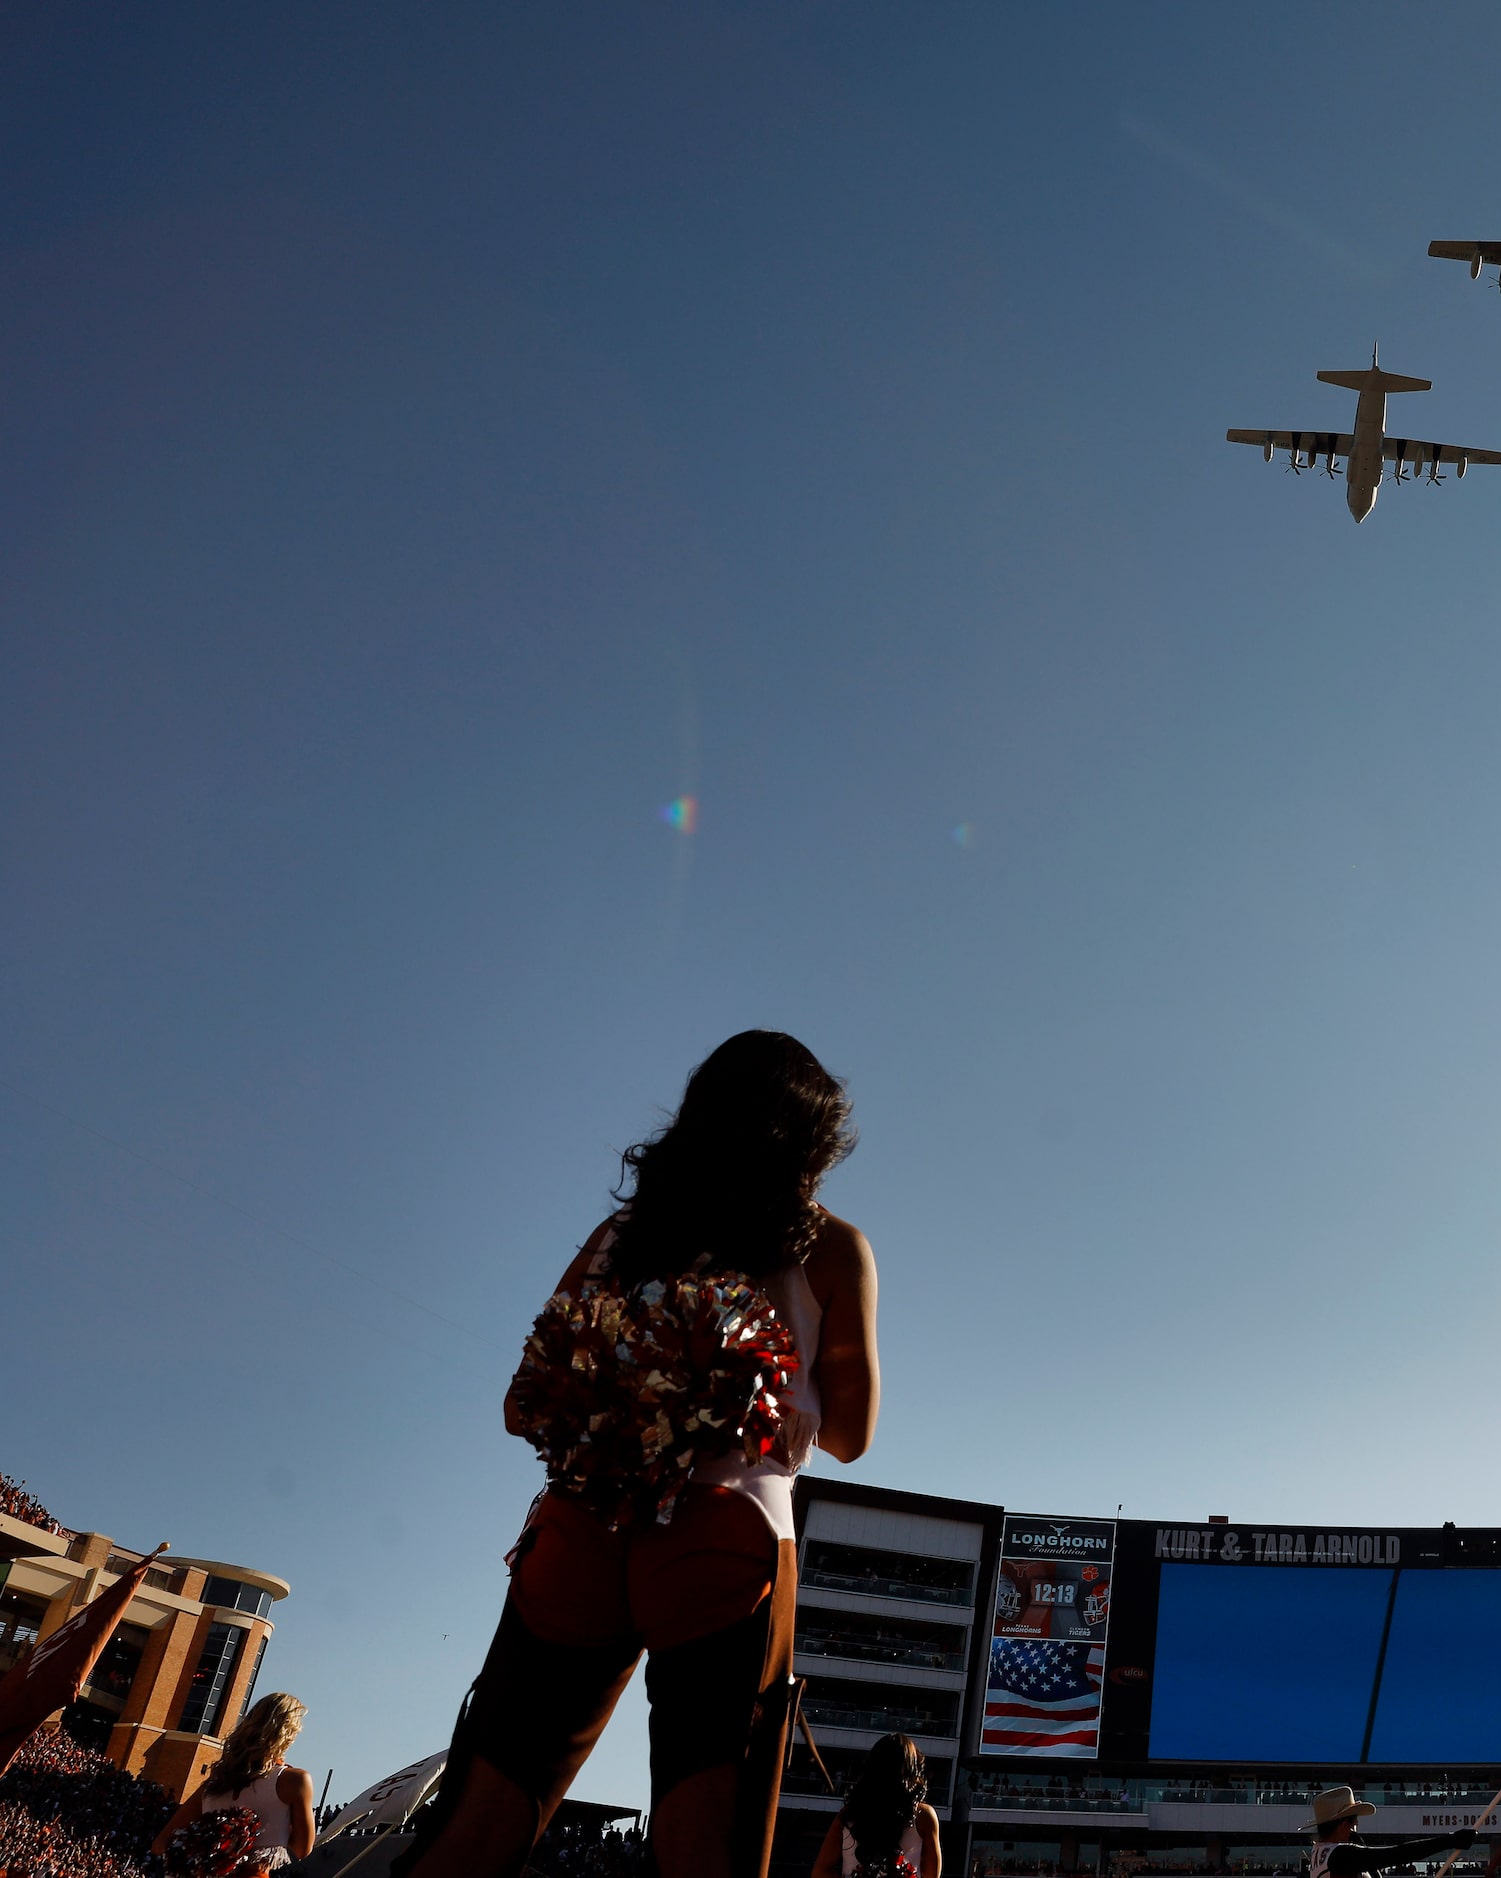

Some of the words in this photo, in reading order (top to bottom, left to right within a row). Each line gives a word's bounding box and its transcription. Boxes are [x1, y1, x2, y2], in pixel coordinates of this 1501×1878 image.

[1011, 1533, 1107, 1549] LONGHORN
[1155, 1529, 1214, 1559] KURT
[1220, 1532, 1243, 1561] &
[1252, 1533, 1309, 1563] TARA
[1312, 1535, 1401, 1565] ARNOLD
[1028, 1544, 1087, 1556] Foundation
[1034, 1583, 1075, 1603] 12:13
[1422, 1815, 1498, 1826] MYERS-DODS
